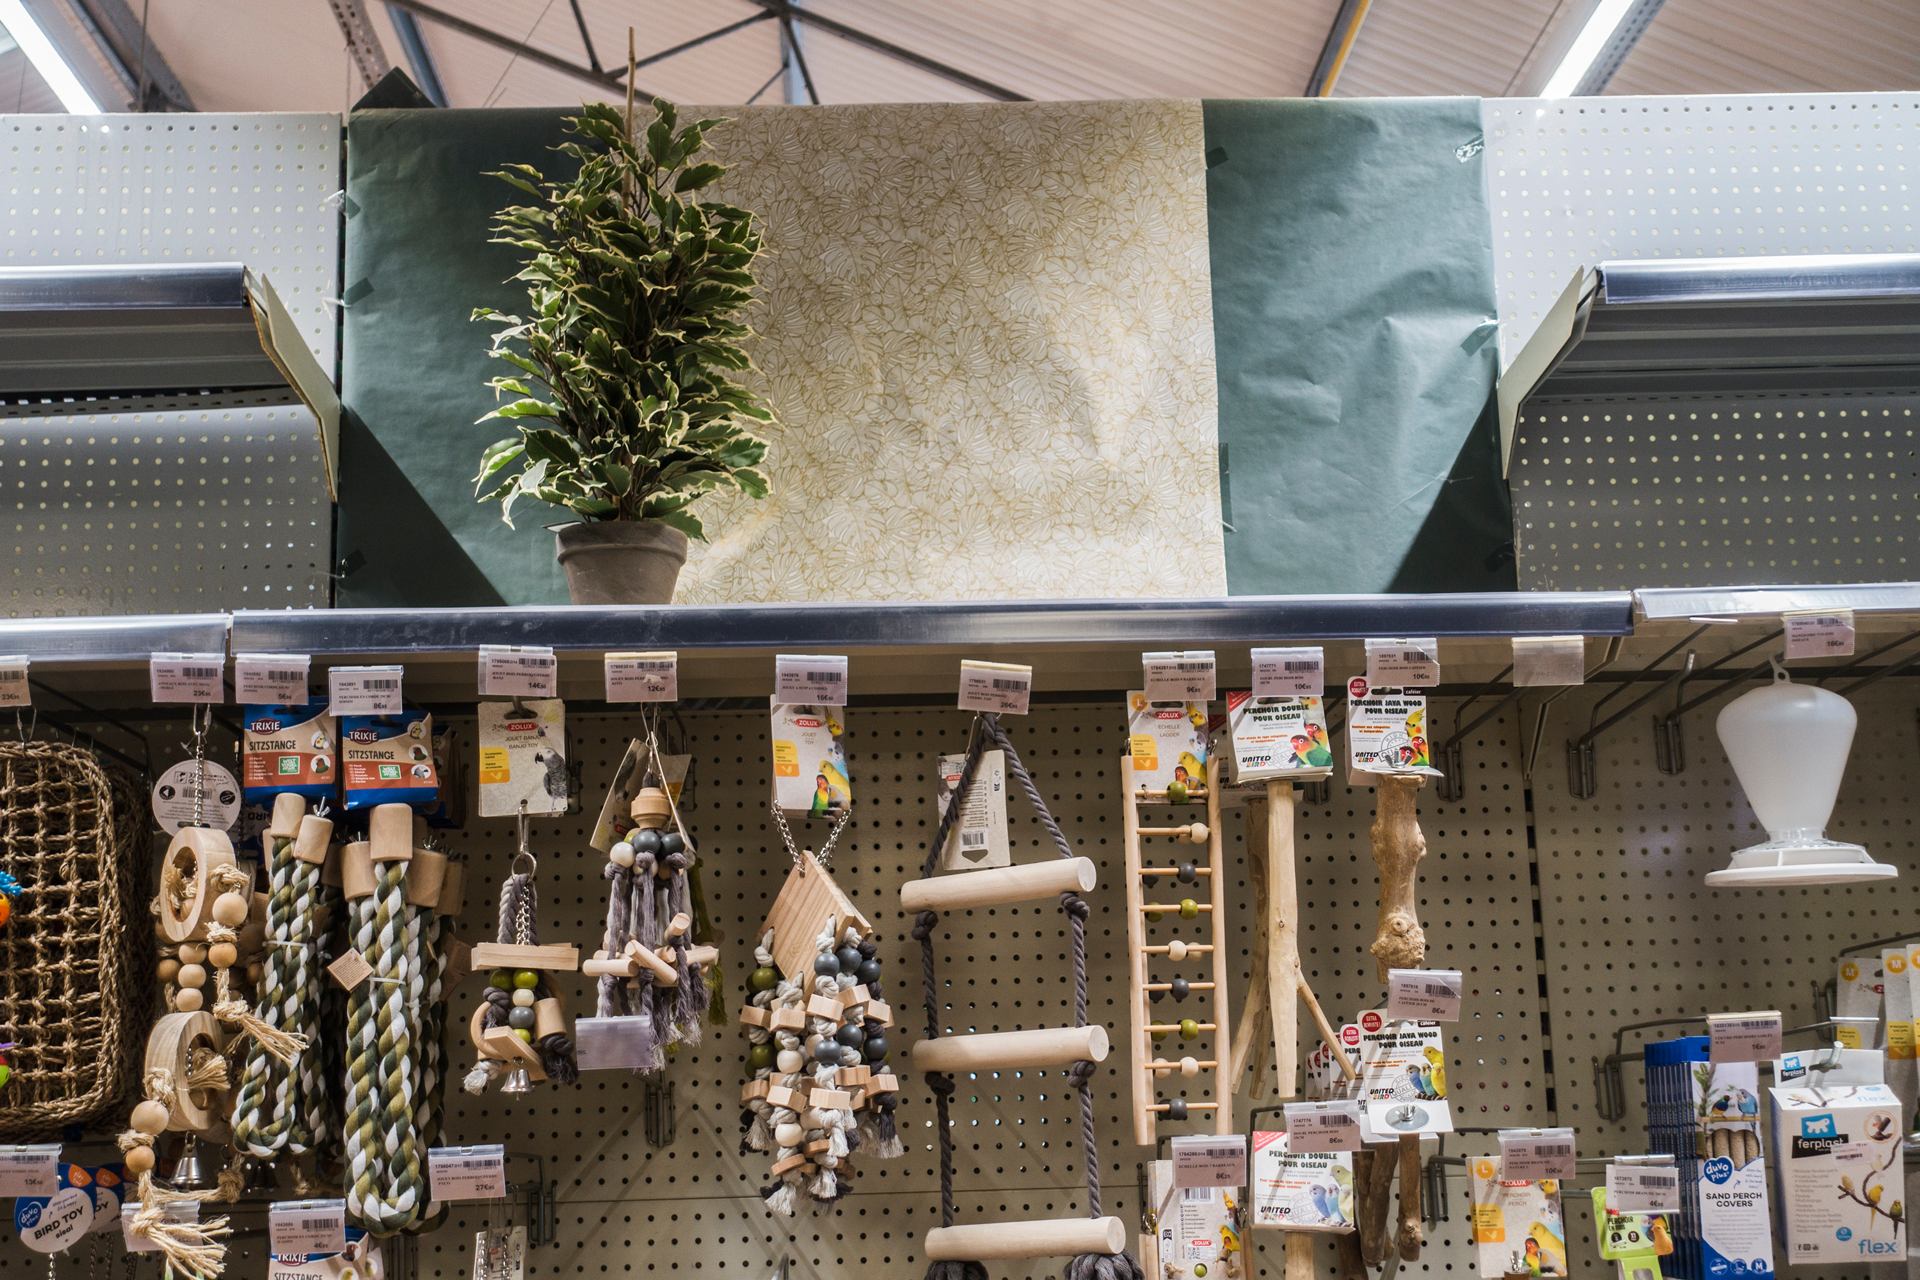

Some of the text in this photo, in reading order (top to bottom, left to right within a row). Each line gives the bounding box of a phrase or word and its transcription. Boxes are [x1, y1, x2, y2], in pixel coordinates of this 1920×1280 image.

[1243, 704, 1309, 714] PERCHOIR DOUBLE
[250, 720, 280, 731] TRIXIE
[349, 731, 377, 741] TRIXIE
[249, 740, 296, 751] SITZSTANGE
[348, 750, 394, 760] SITZSTANGE
[1242, 755, 1271, 763] UNITED
[1269, 1150, 1306, 1159] PERCHOIR
[1278, 1160, 1298, 1168] POUR
[1706, 1163, 1729, 1174] duvo
[1706, 1192, 1762, 1200] SAND PERCH
[95, 1201, 109, 1212] OY
[1716, 1200, 1753, 1208] COVERS
[1260, 1206, 1291, 1214] UNITED
[21, 1207, 38, 1224] duvo
[34, 1206, 84, 1240] BIRD TOY
[55, 1224, 74, 1239] sisal
[1858, 1239, 1897, 1255] flex
[278, 1253, 308, 1262] TRIXIE
[274, 1272, 323, 1280] SITZSTANGE
